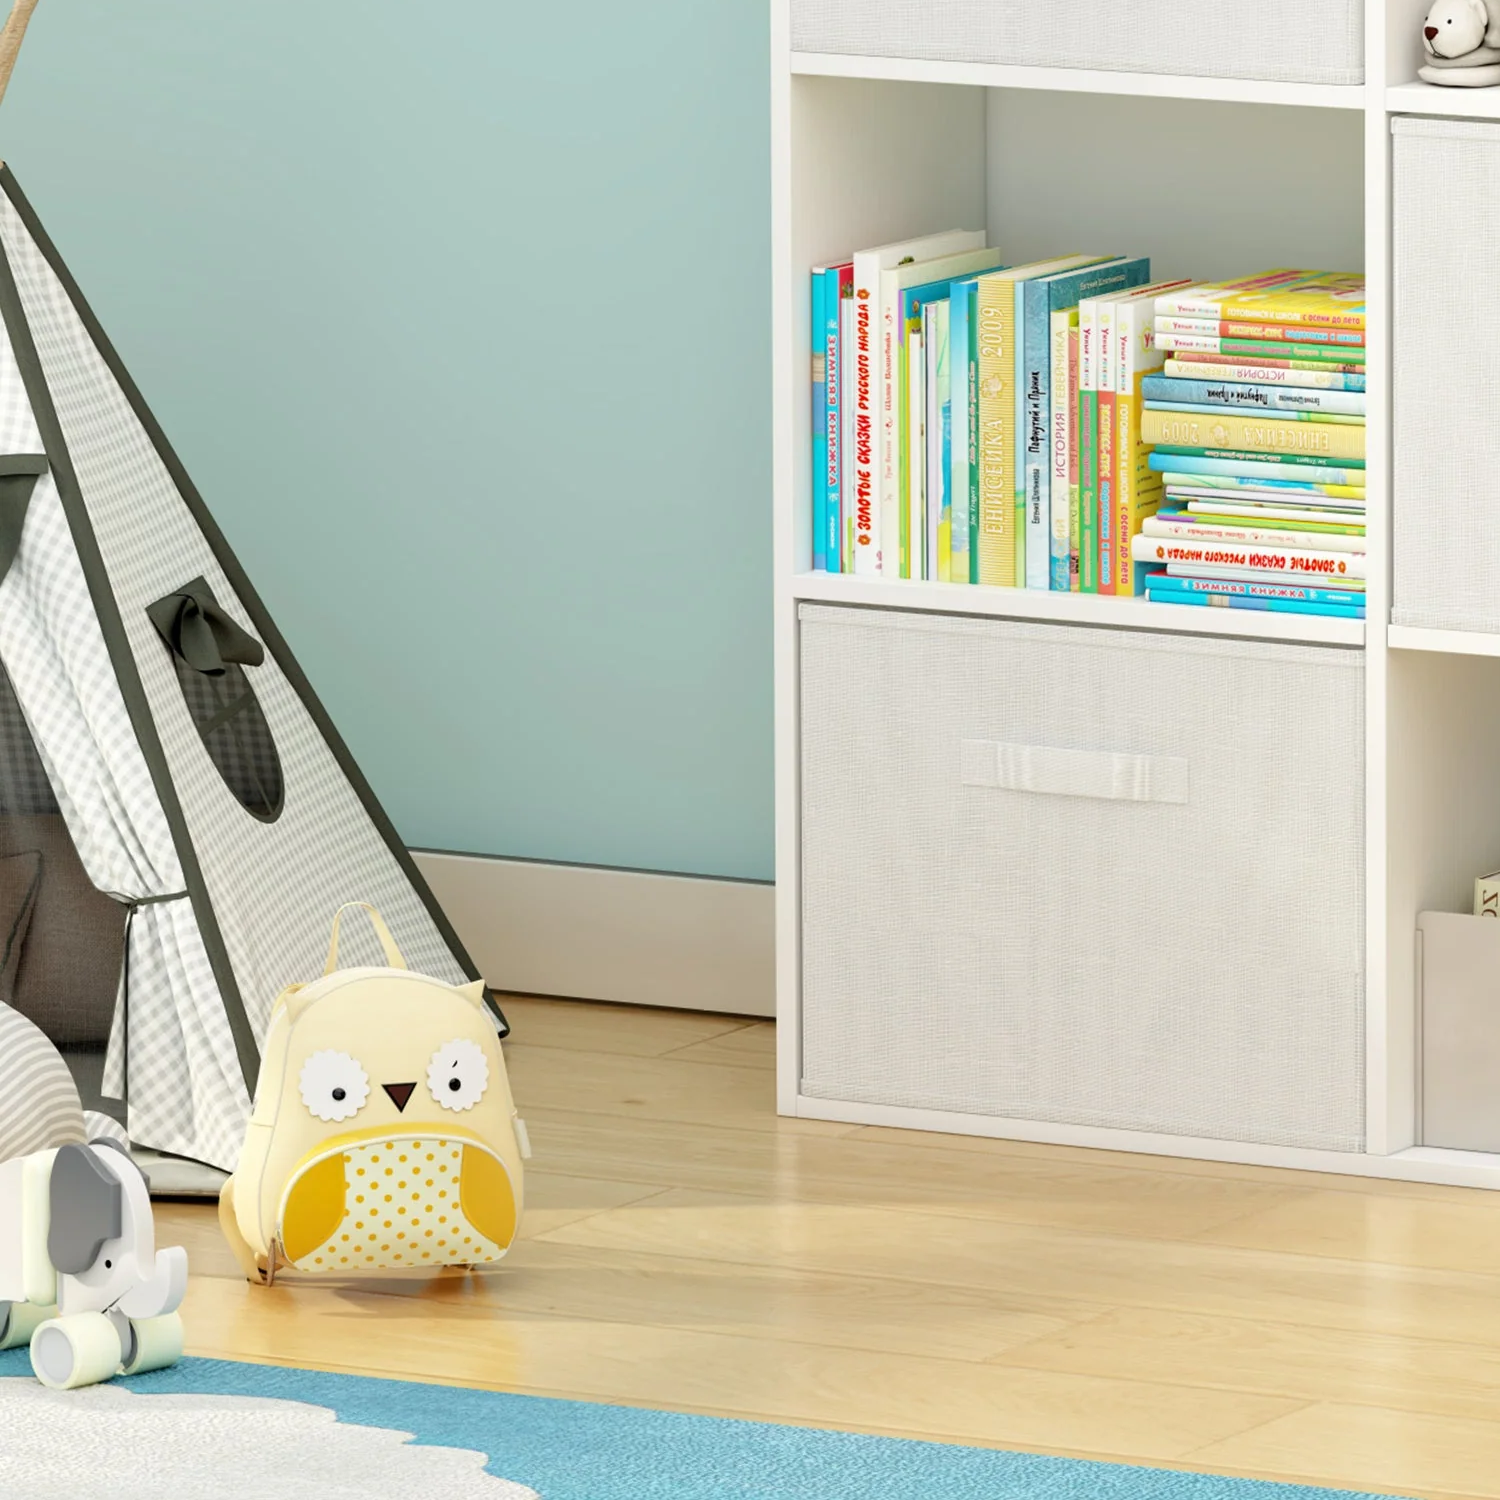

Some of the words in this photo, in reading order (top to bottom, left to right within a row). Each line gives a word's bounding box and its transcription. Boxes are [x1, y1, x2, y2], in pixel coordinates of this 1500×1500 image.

[856, 303, 870, 352] НАРОДА
[982, 306, 1004, 358] 2009
[1310, 314, 1331, 323] осени
[1332, 316, 1342, 324] до
[1343, 317, 1361, 325] лета
[827, 334, 838, 406] ЗИМНЯЯ
[857, 353, 871, 411] РУССКОГО
[1236, 367, 1286, 381] ИСТОРИЯ
[1028, 371, 1046, 401] Пряник
[856, 414, 872, 465] СКАЗКИ
[1028, 411, 1046, 454] Пафнутий
[1055, 412, 1066, 478] ИСТОРИЯ
[1161, 422, 1199, 439] 2009
[1243, 422, 1330, 450] ЕНИСЕЙКА
[828, 412, 838, 486] КНИЖКА
[985, 418, 1005, 535] ЕНИСЕЙКА
[857, 469, 872, 531] ЗОЛОТЫЕ
[1120, 514, 1128, 543] осени
[1119, 545, 1130, 558] до
[1166, 547, 1203, 562] НАРОДА
[1204, 550, 1246, 565] РУССКОГО
[1248, 553, 1287, 571] СКАЗКИ
[1289, 555, 1335, 574] ЗОЛОТЫЕ
[1120, 560, 1128, 585] лета
[1193, 581, 1246, 593] ЗИМНЯЯ
[1249, 586, 1306, 599] КНИЖКА
